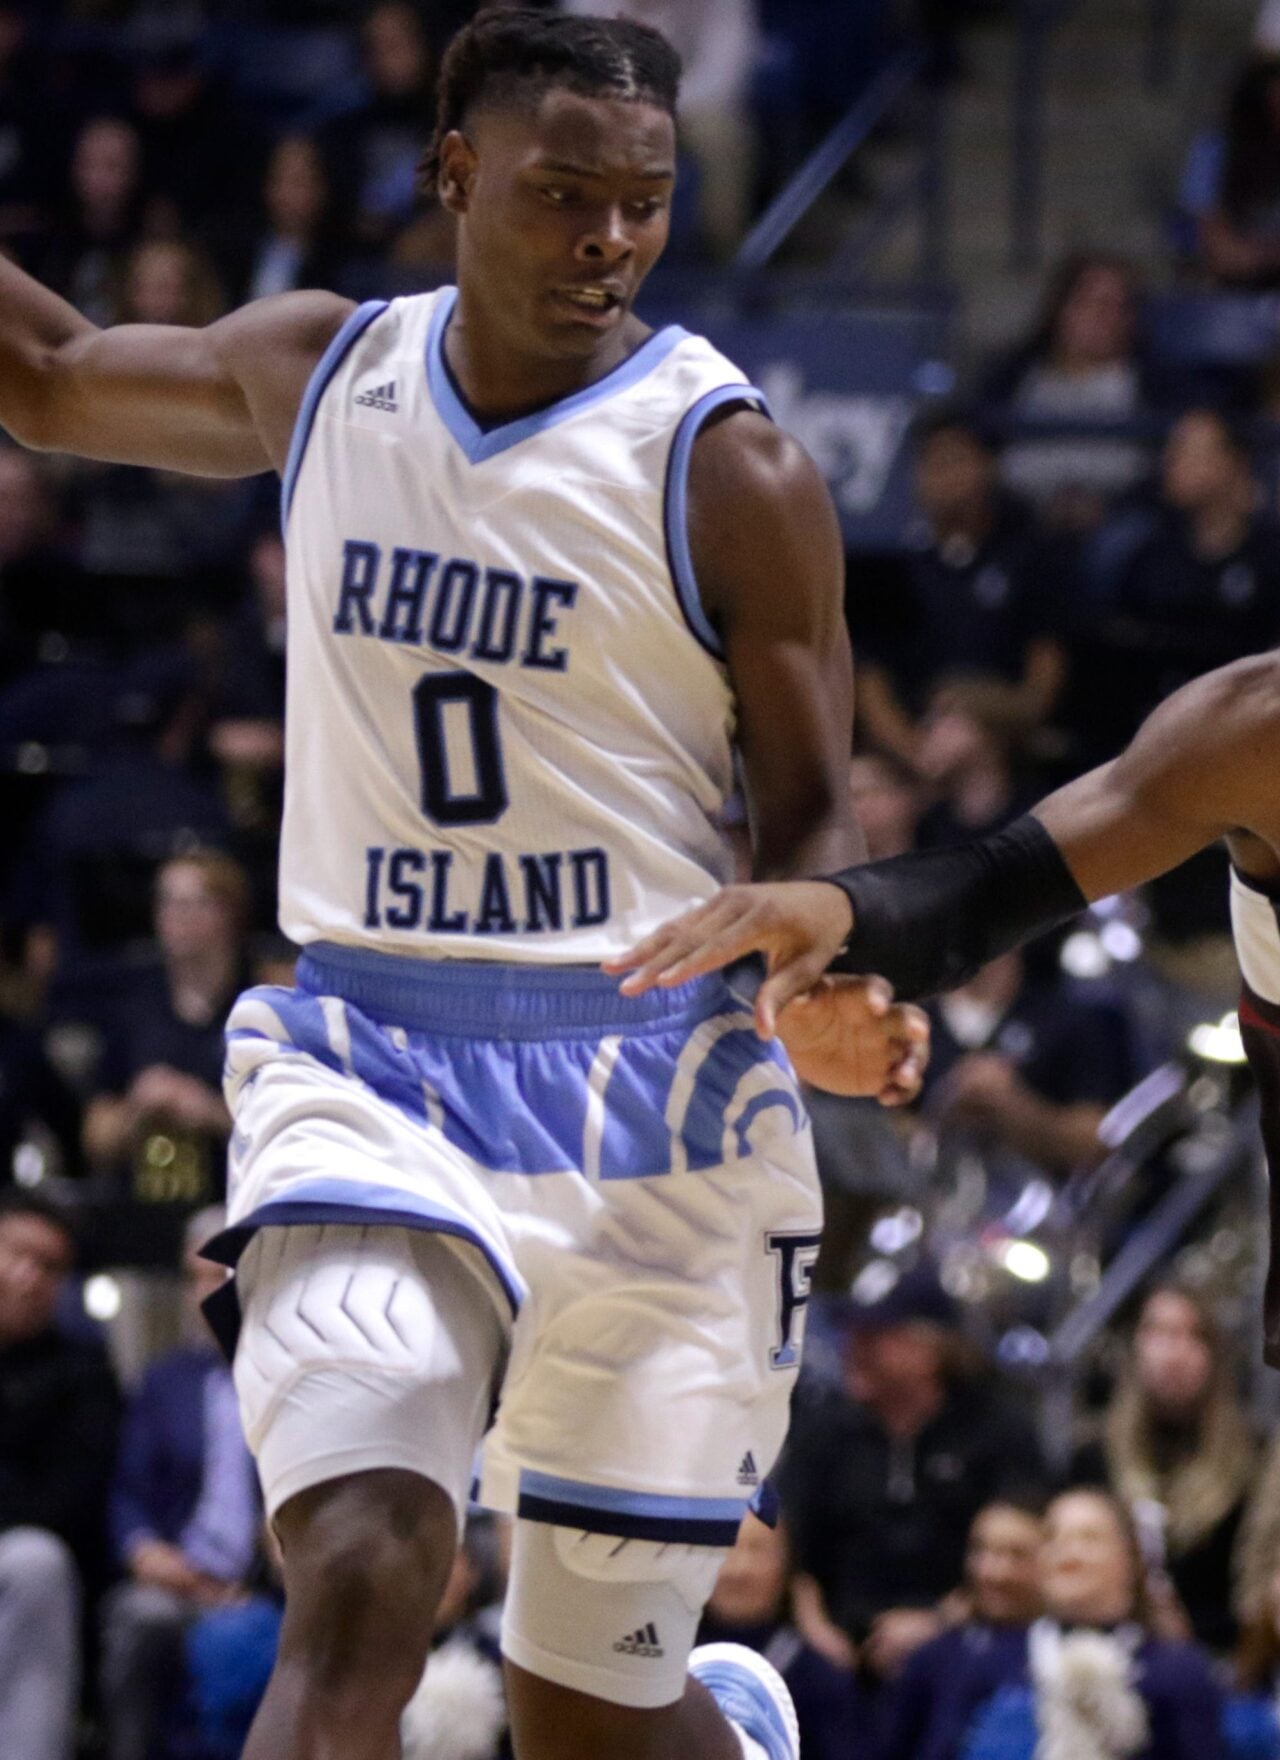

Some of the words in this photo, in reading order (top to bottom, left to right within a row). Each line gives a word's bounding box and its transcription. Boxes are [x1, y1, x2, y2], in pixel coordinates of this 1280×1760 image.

[333, 539, 579, 673] RHODE
[411, 668, 510, 829] 0
[363, 845, 611, 935] ISLAND
